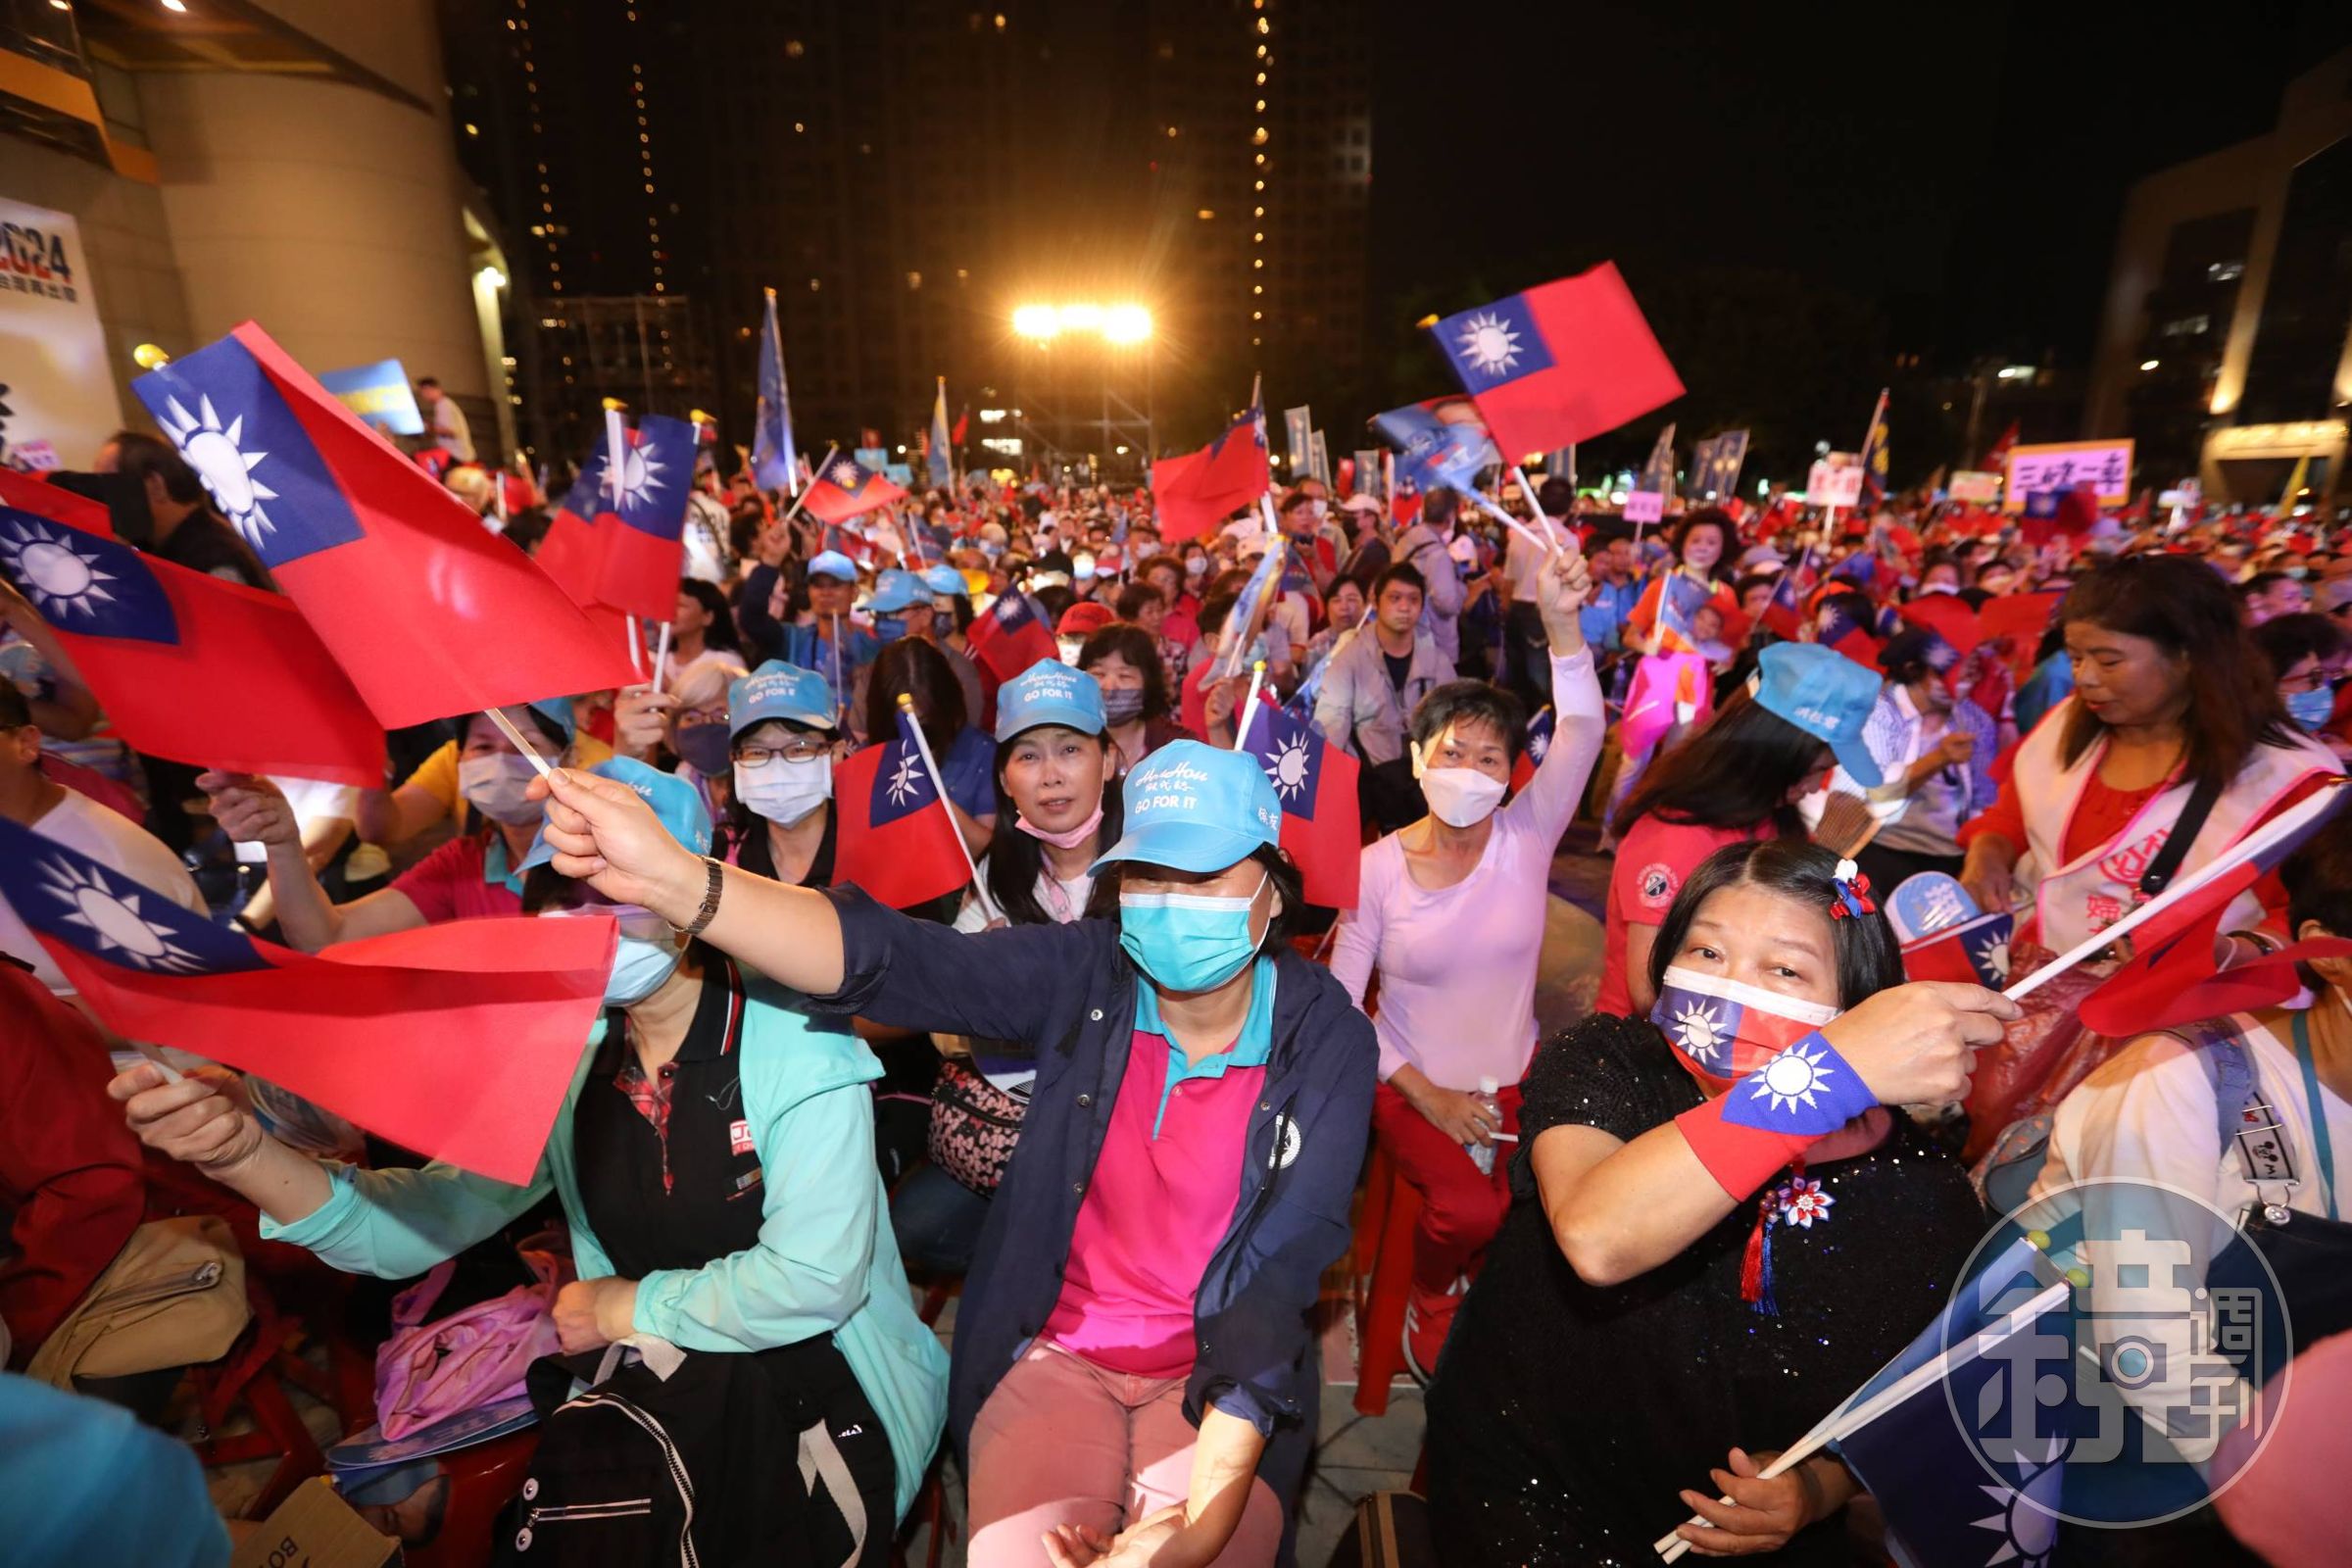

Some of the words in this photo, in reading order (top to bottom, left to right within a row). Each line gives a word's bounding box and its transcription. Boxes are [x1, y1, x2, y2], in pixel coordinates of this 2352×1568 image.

[1135, 798, 1151, 814] GO
[1152, 795, 1179, 808] FOR
[1183, 796, 1198, 809] IT
